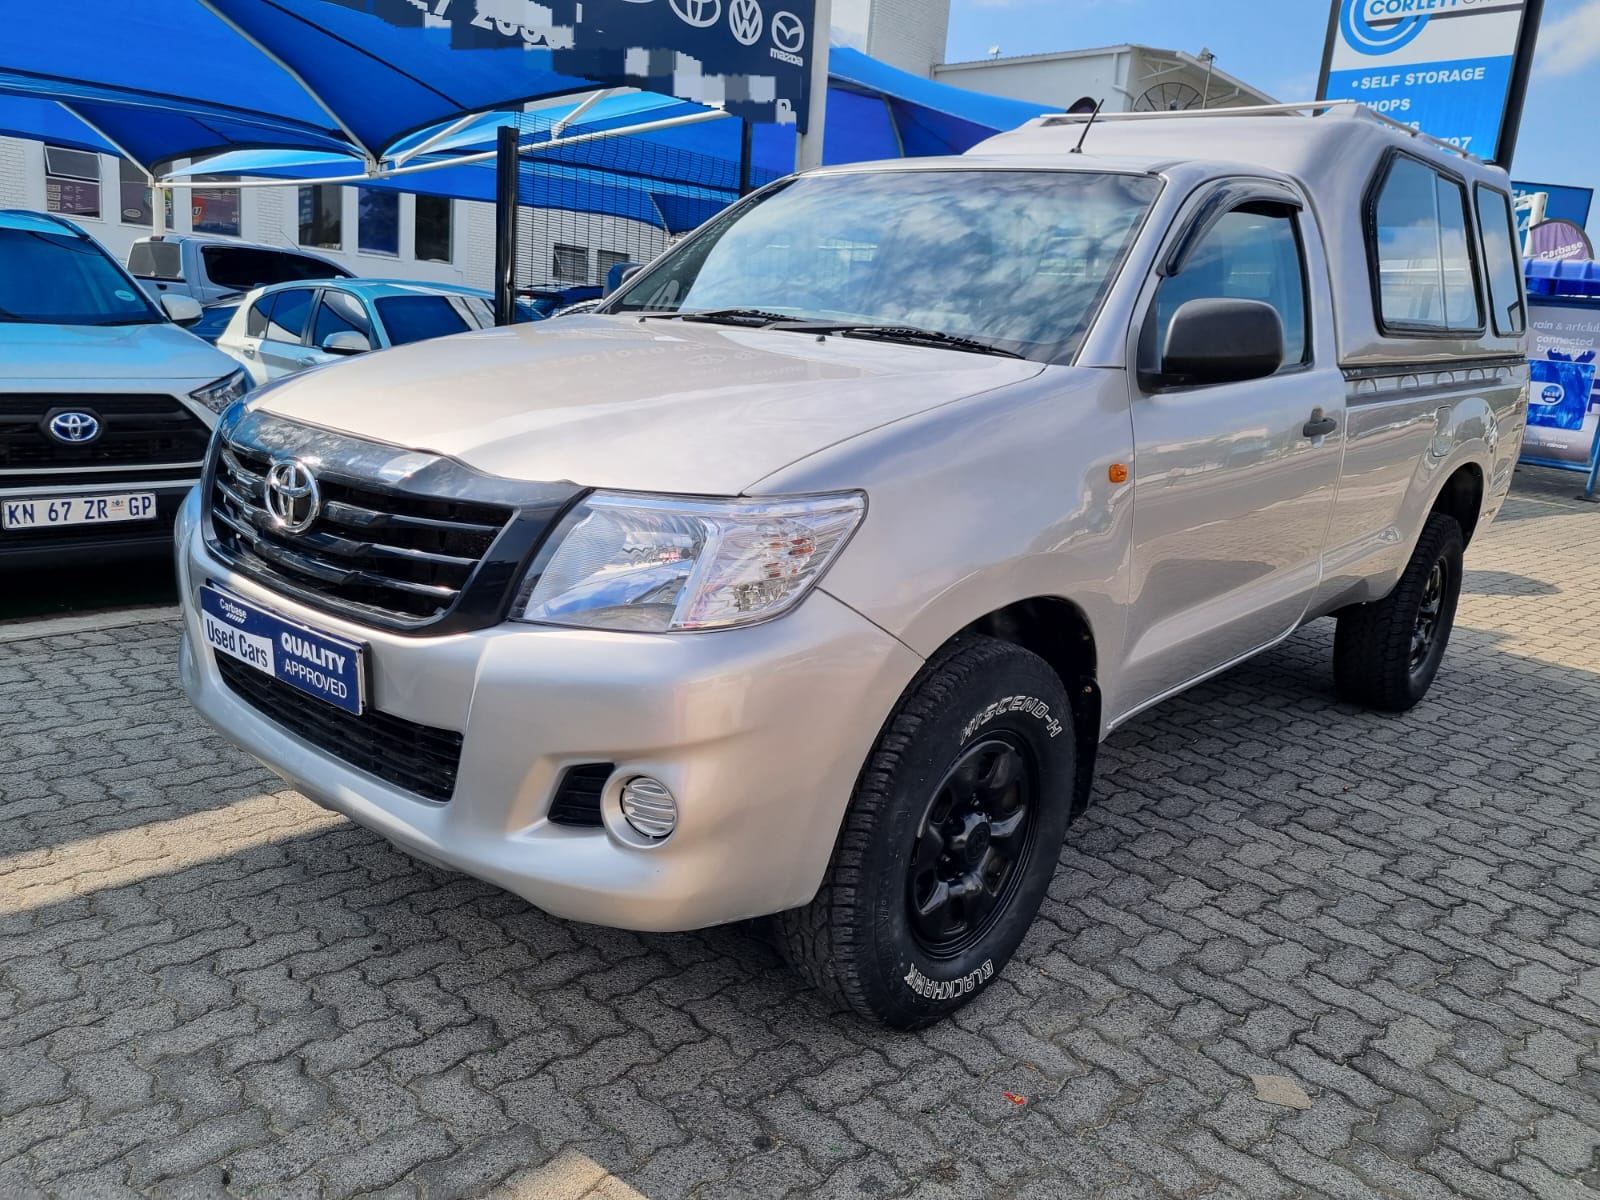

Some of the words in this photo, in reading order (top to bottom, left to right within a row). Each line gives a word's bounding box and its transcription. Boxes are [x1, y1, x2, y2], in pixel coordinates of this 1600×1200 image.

[770, 48, 803, 67] mazda
[1360, 75, 1400, 89] SELF
[1404, 67, 1486, 86] STORAGE
[1360, 98, 1411, 112] HOPS
[1533, 320, 1554, 330] rain
[1536, 335, 1594, 347] connected
[1551, 344, 1588, 359] design
[8, 504, 35, 525] KN
[48, 501, 73, 521] 67
[84, 499, 109, 519] ZR
[129, 496, 151, 516] GP
[219, 598, 247, 619] Carbase
[206, 619, 236, 653] Used
[238, 633, 268, 668] Cars
[281, 632, 346, 675] QUALITY
[284, 658, 347, 699] APPROVED
[903, 958, 994, 1000] BLACKHAWK
